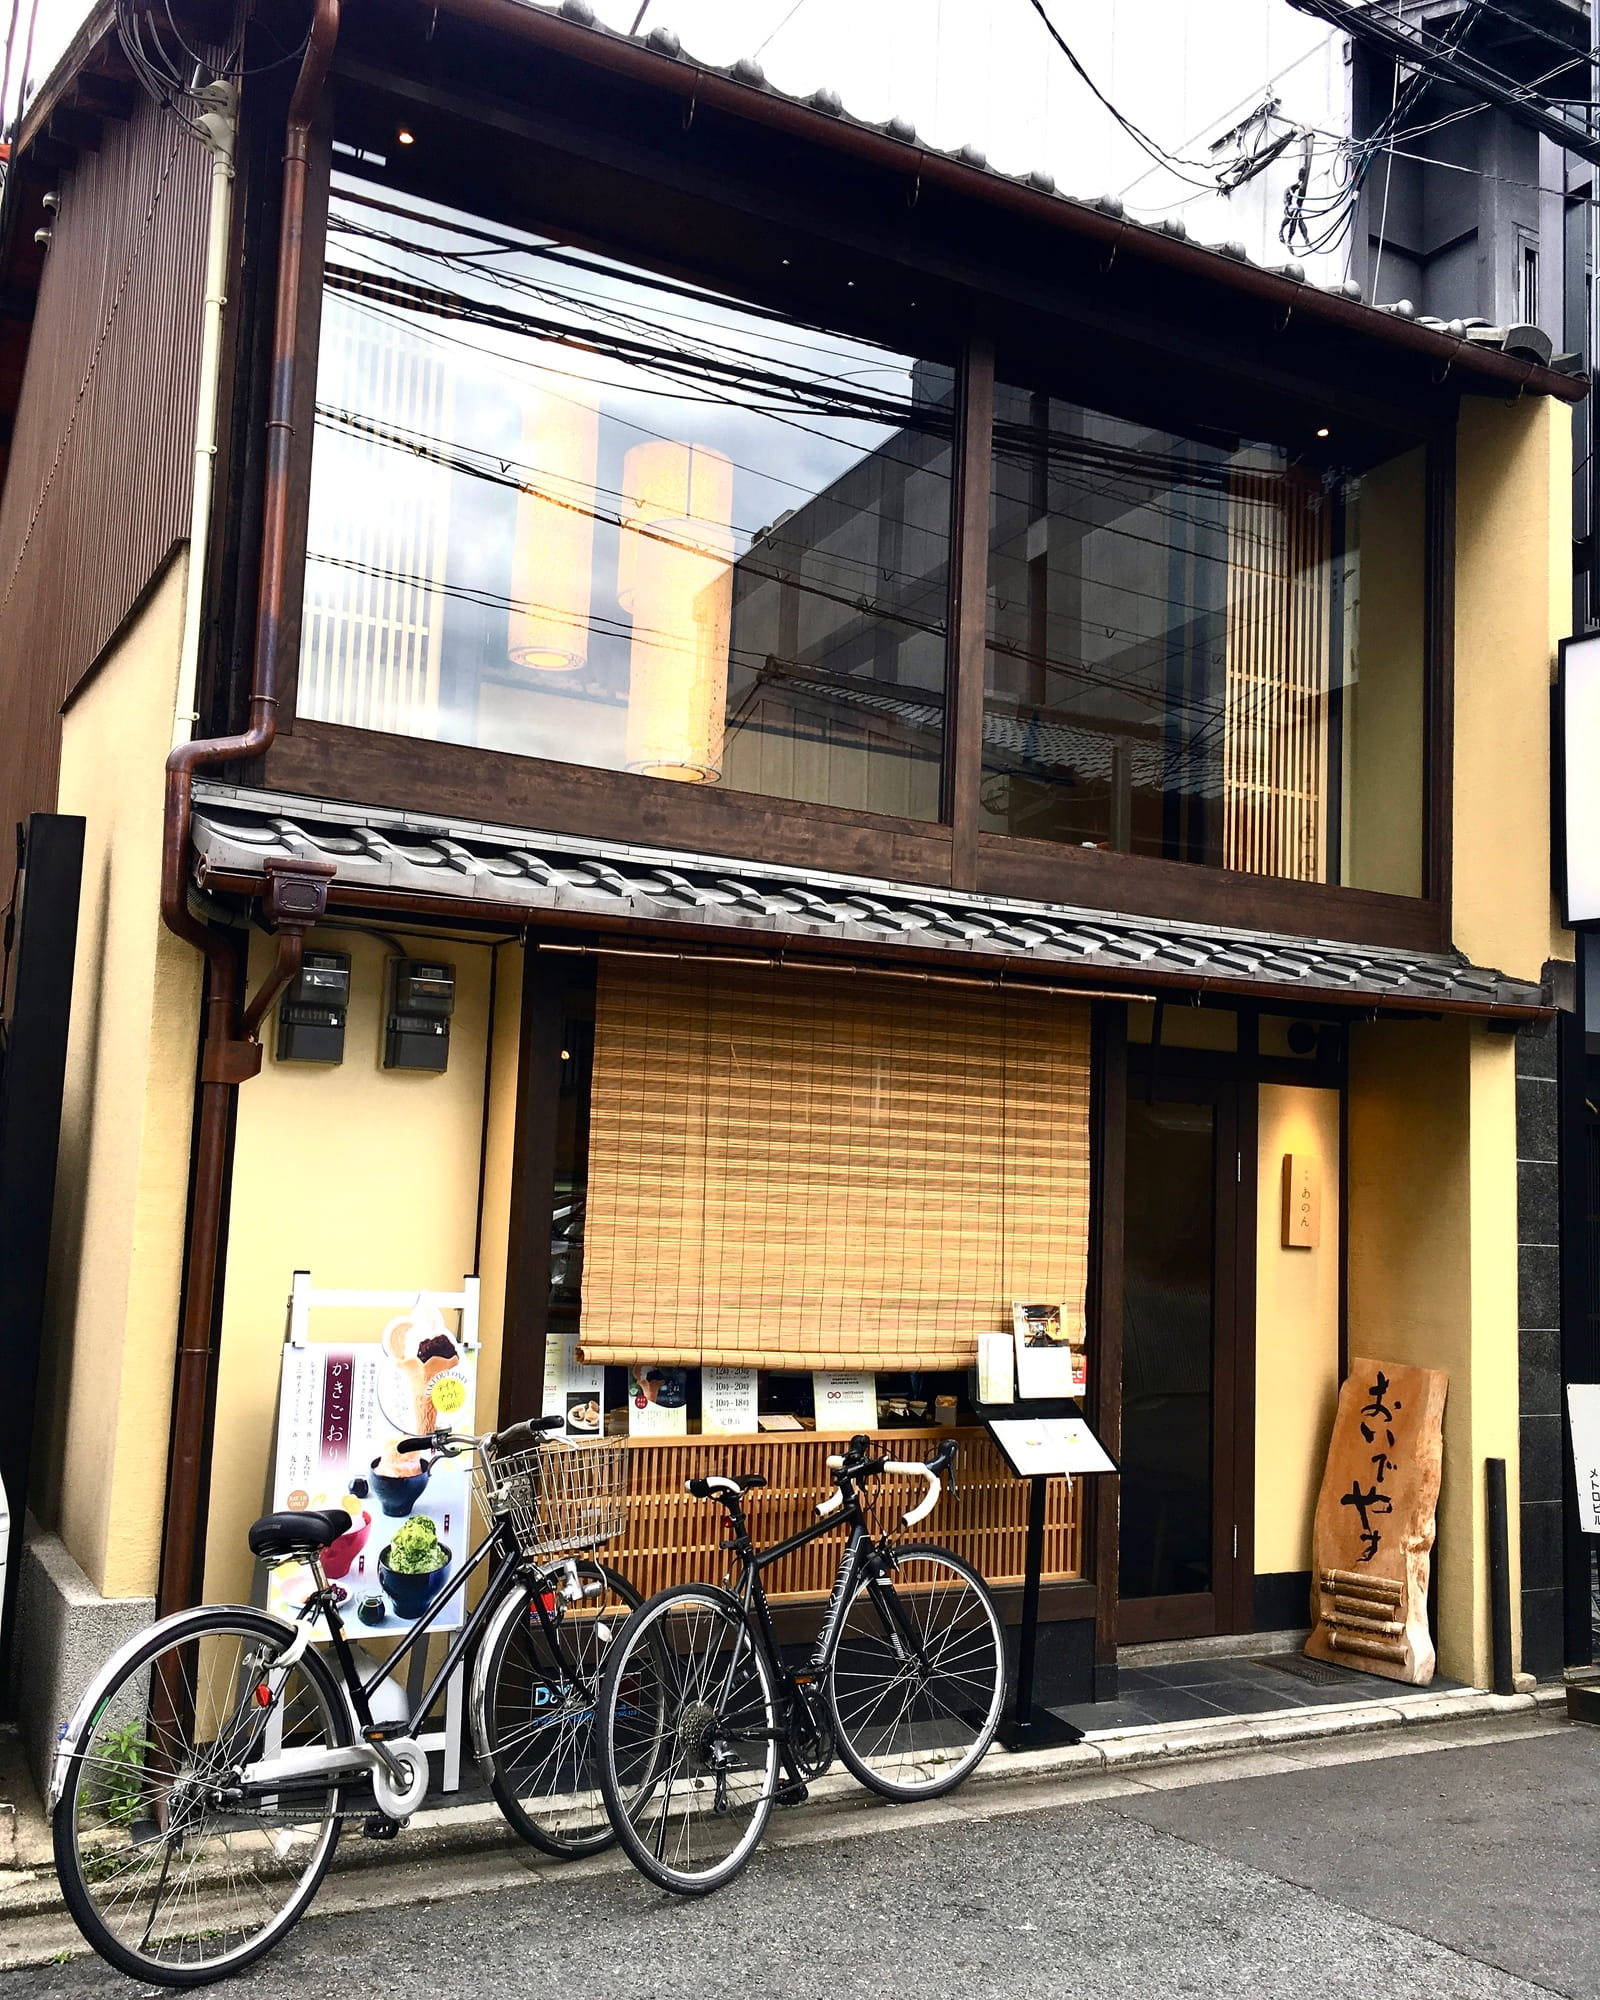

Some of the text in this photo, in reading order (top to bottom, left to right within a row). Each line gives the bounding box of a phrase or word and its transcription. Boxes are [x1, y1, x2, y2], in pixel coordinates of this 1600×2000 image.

[1300, 1187, 1311, 1227] あのん
[326, 1361, 349, 1465] かきごおり
[1340, 1370, 1402, 1563] おいでやす
[1589, 1468, 1600, 1525] メトロビル
